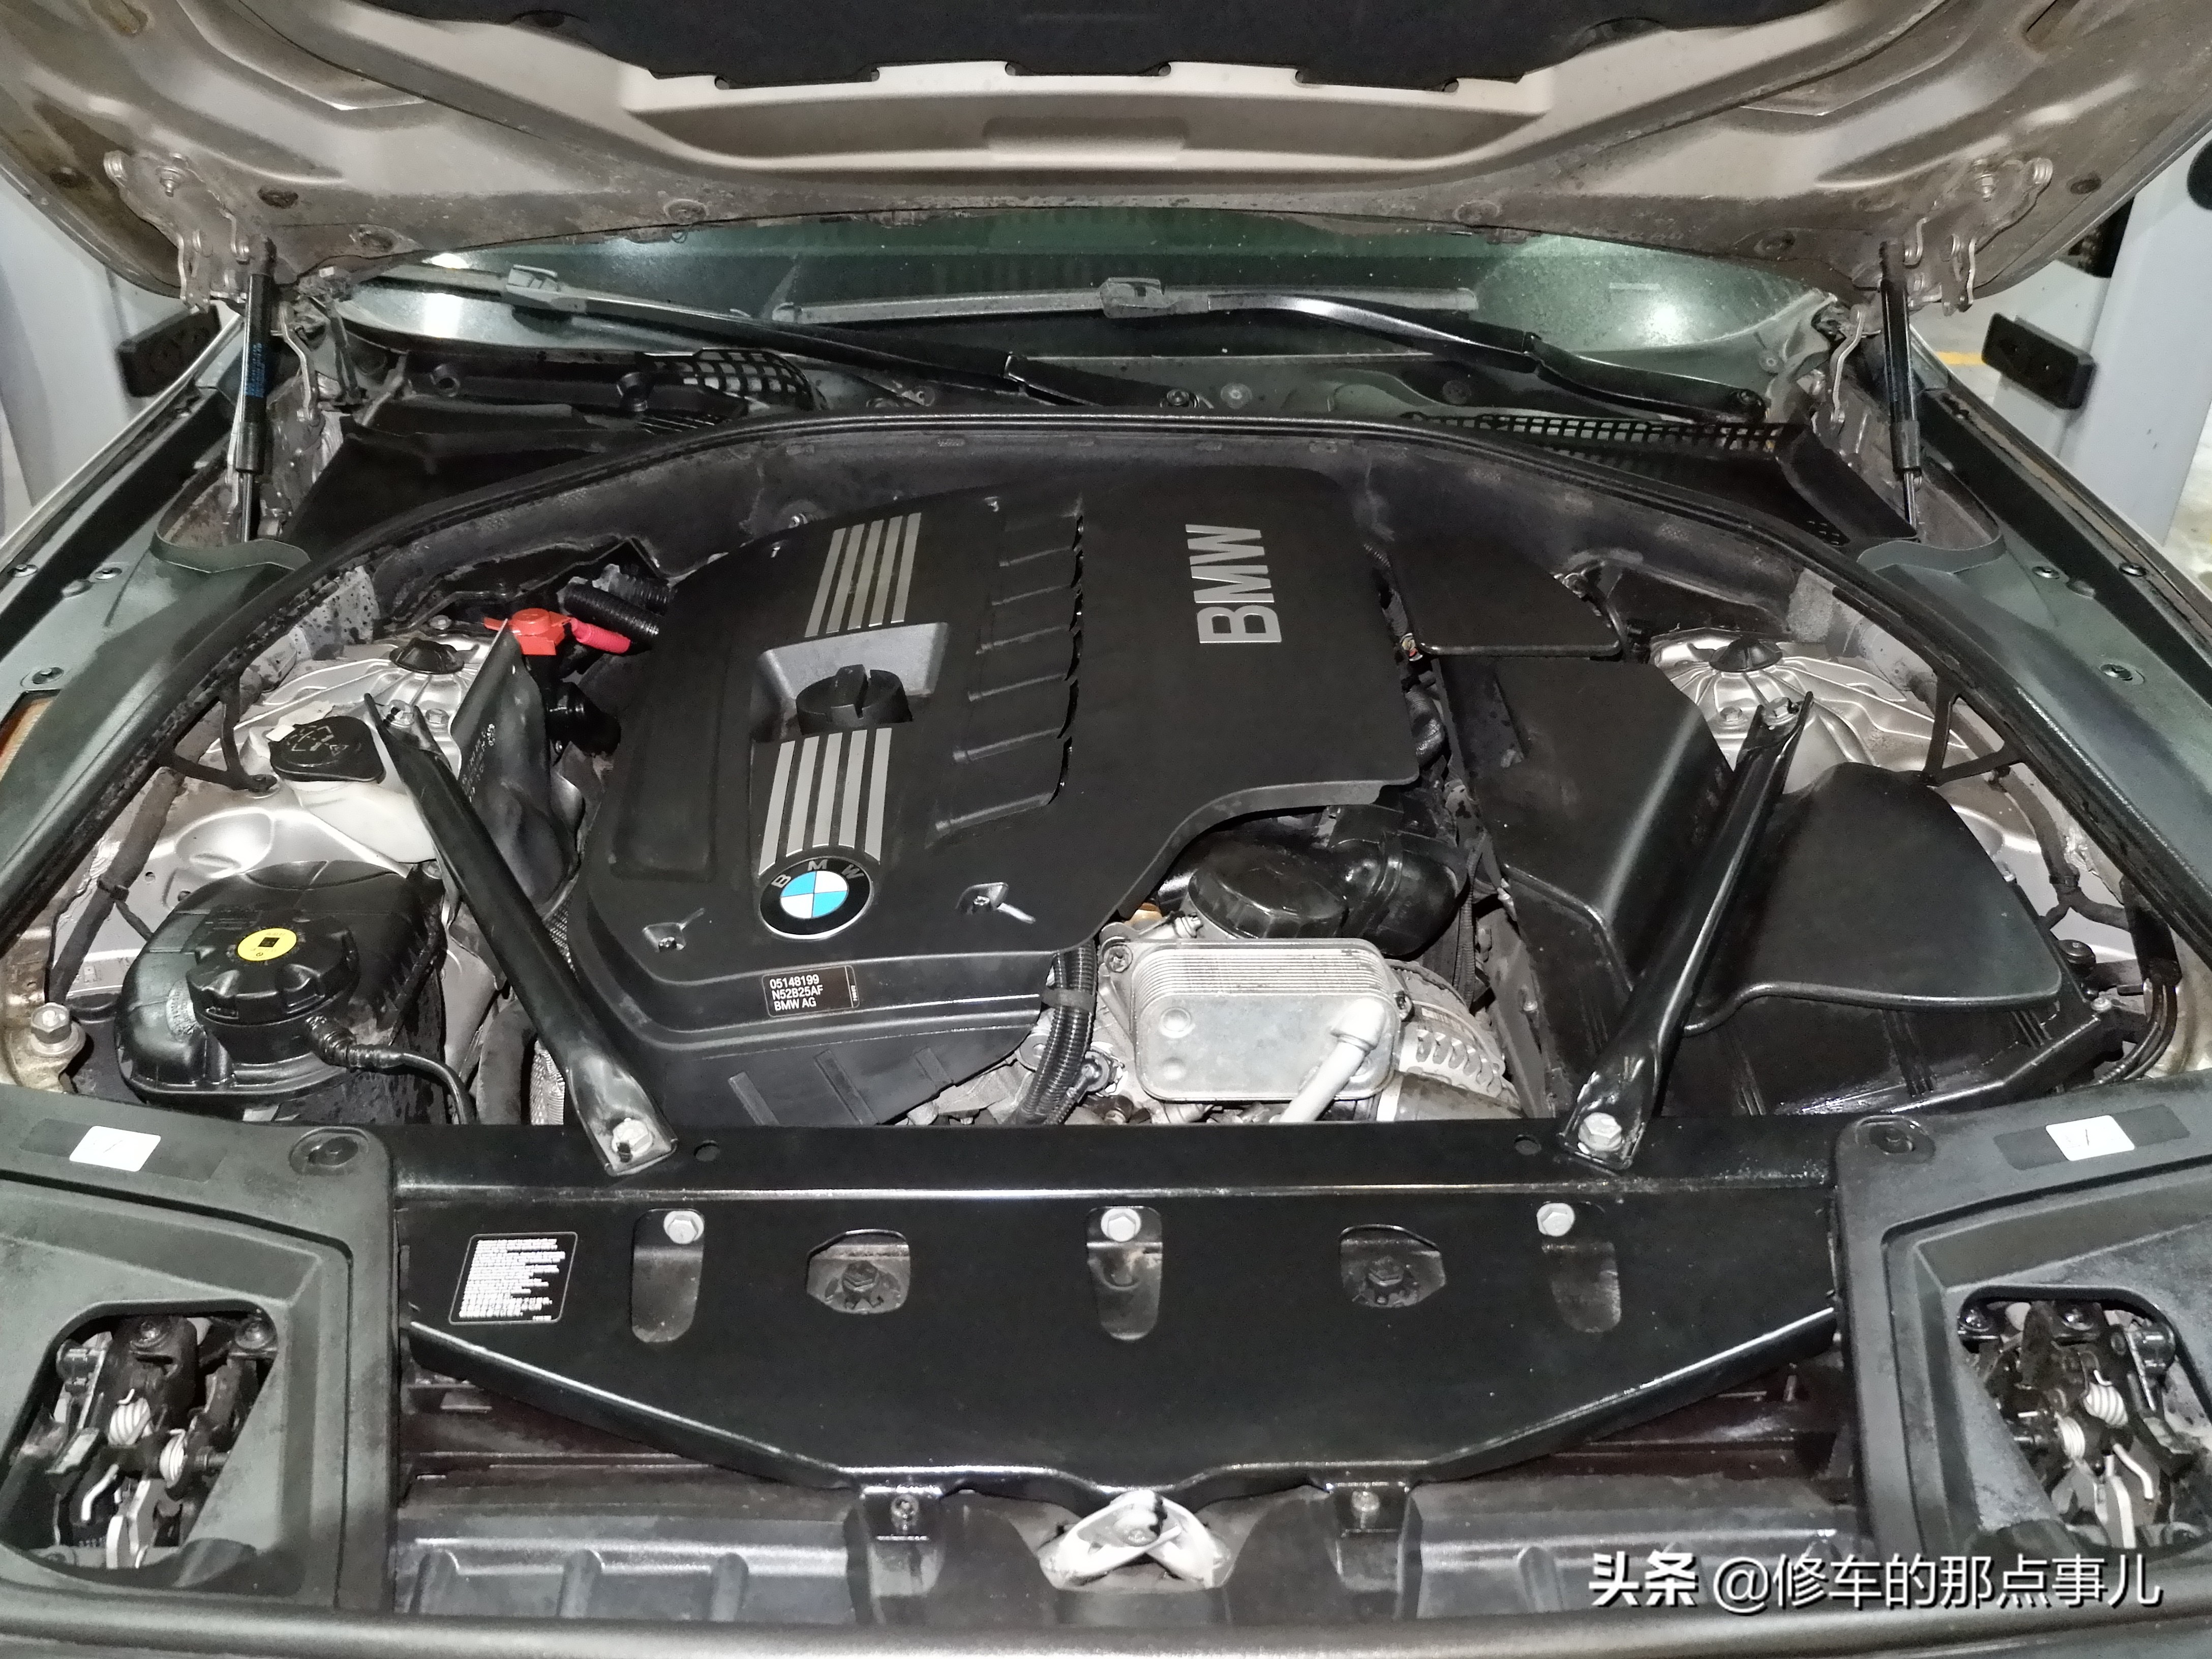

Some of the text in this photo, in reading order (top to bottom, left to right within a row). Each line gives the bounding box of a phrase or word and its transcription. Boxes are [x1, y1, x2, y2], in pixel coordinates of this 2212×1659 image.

[1185, 524, 1282, 643] BMW
[771, 859, 864, 888] BMW
[769, 974, 820, 989] 05148199
[771, 985, 824, 1000] N52B25AF
[774, 997, 816, 1011] BMW AG
